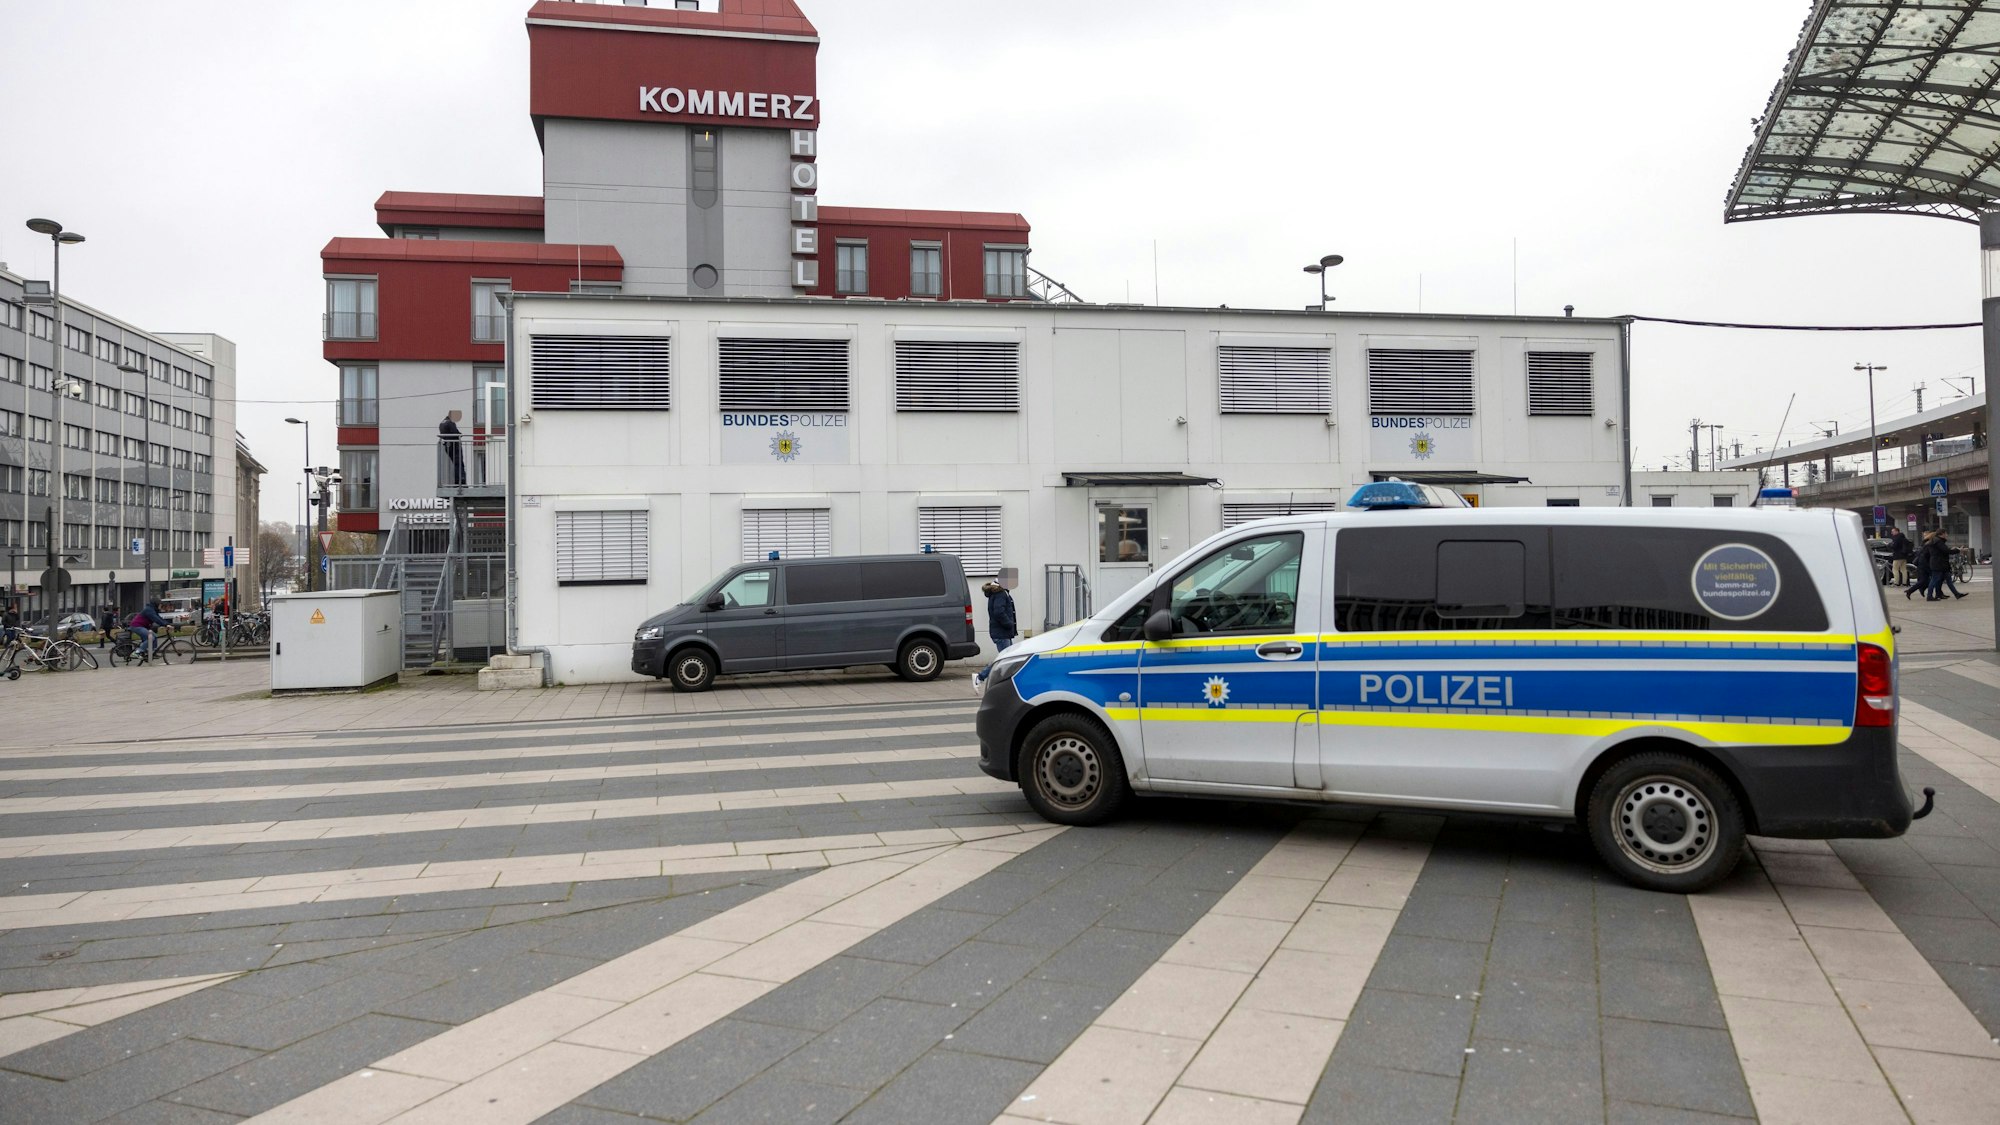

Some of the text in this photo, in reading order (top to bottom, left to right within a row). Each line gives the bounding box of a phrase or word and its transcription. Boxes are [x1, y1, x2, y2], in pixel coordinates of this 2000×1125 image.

[639, 86, 814, 120] KOMMERZ
[793, 131, 816, 285] HOTEL
[723, 414, 847, 427] BUNDESPOLIZEI
[1371, 417, 1471, 429] BUNDESPOLIZEI
[388, 498, 451, 510] KOMMER
[1703, 562, 1768, 571] Mit Sicherheit
[1714, 572, 1757, 582] vielfältig.
[1702, 589, 1771, 598] bundespolizei.de
[1359, 674, 1513, 706] POLIZEI
